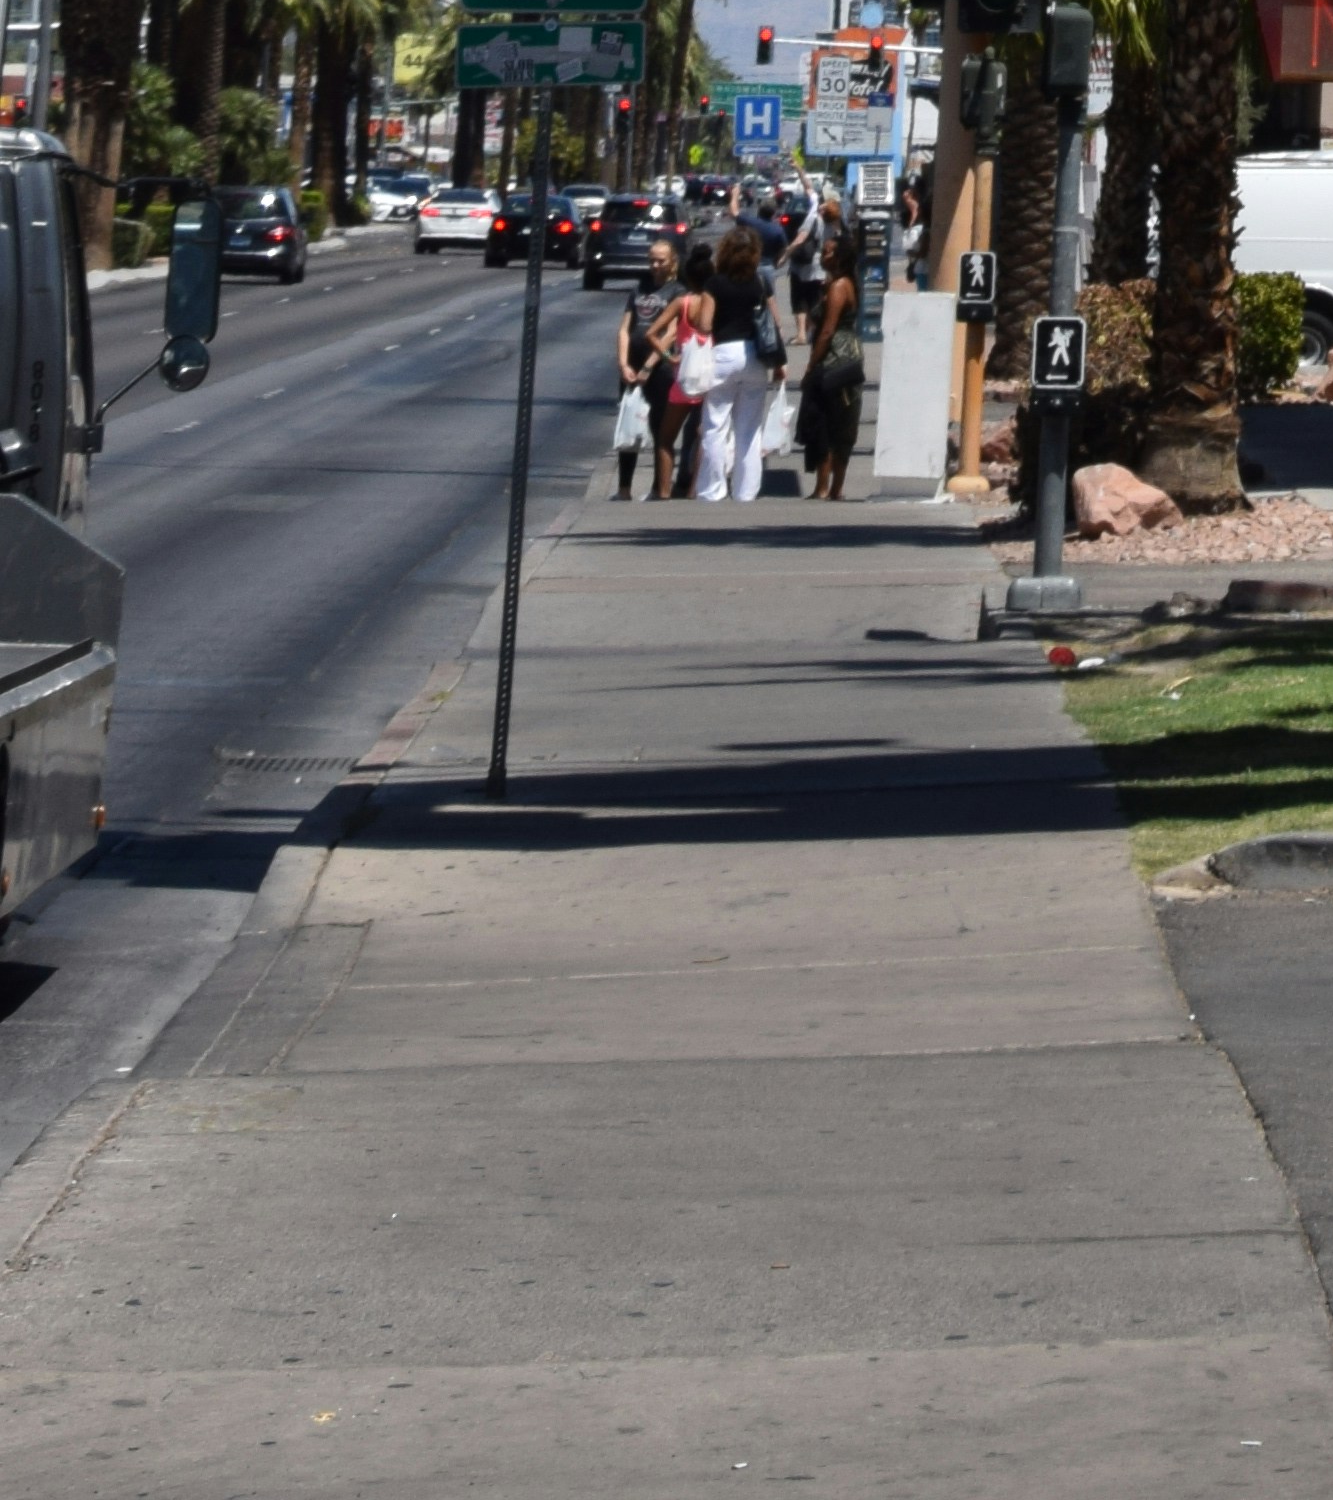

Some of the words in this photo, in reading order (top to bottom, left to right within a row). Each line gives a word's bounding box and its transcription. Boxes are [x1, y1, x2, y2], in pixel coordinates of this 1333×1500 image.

[821, 60, 848, 68] SPEED
[821, 77, 846, 93] 30
[744, 102, 772, 136] H
